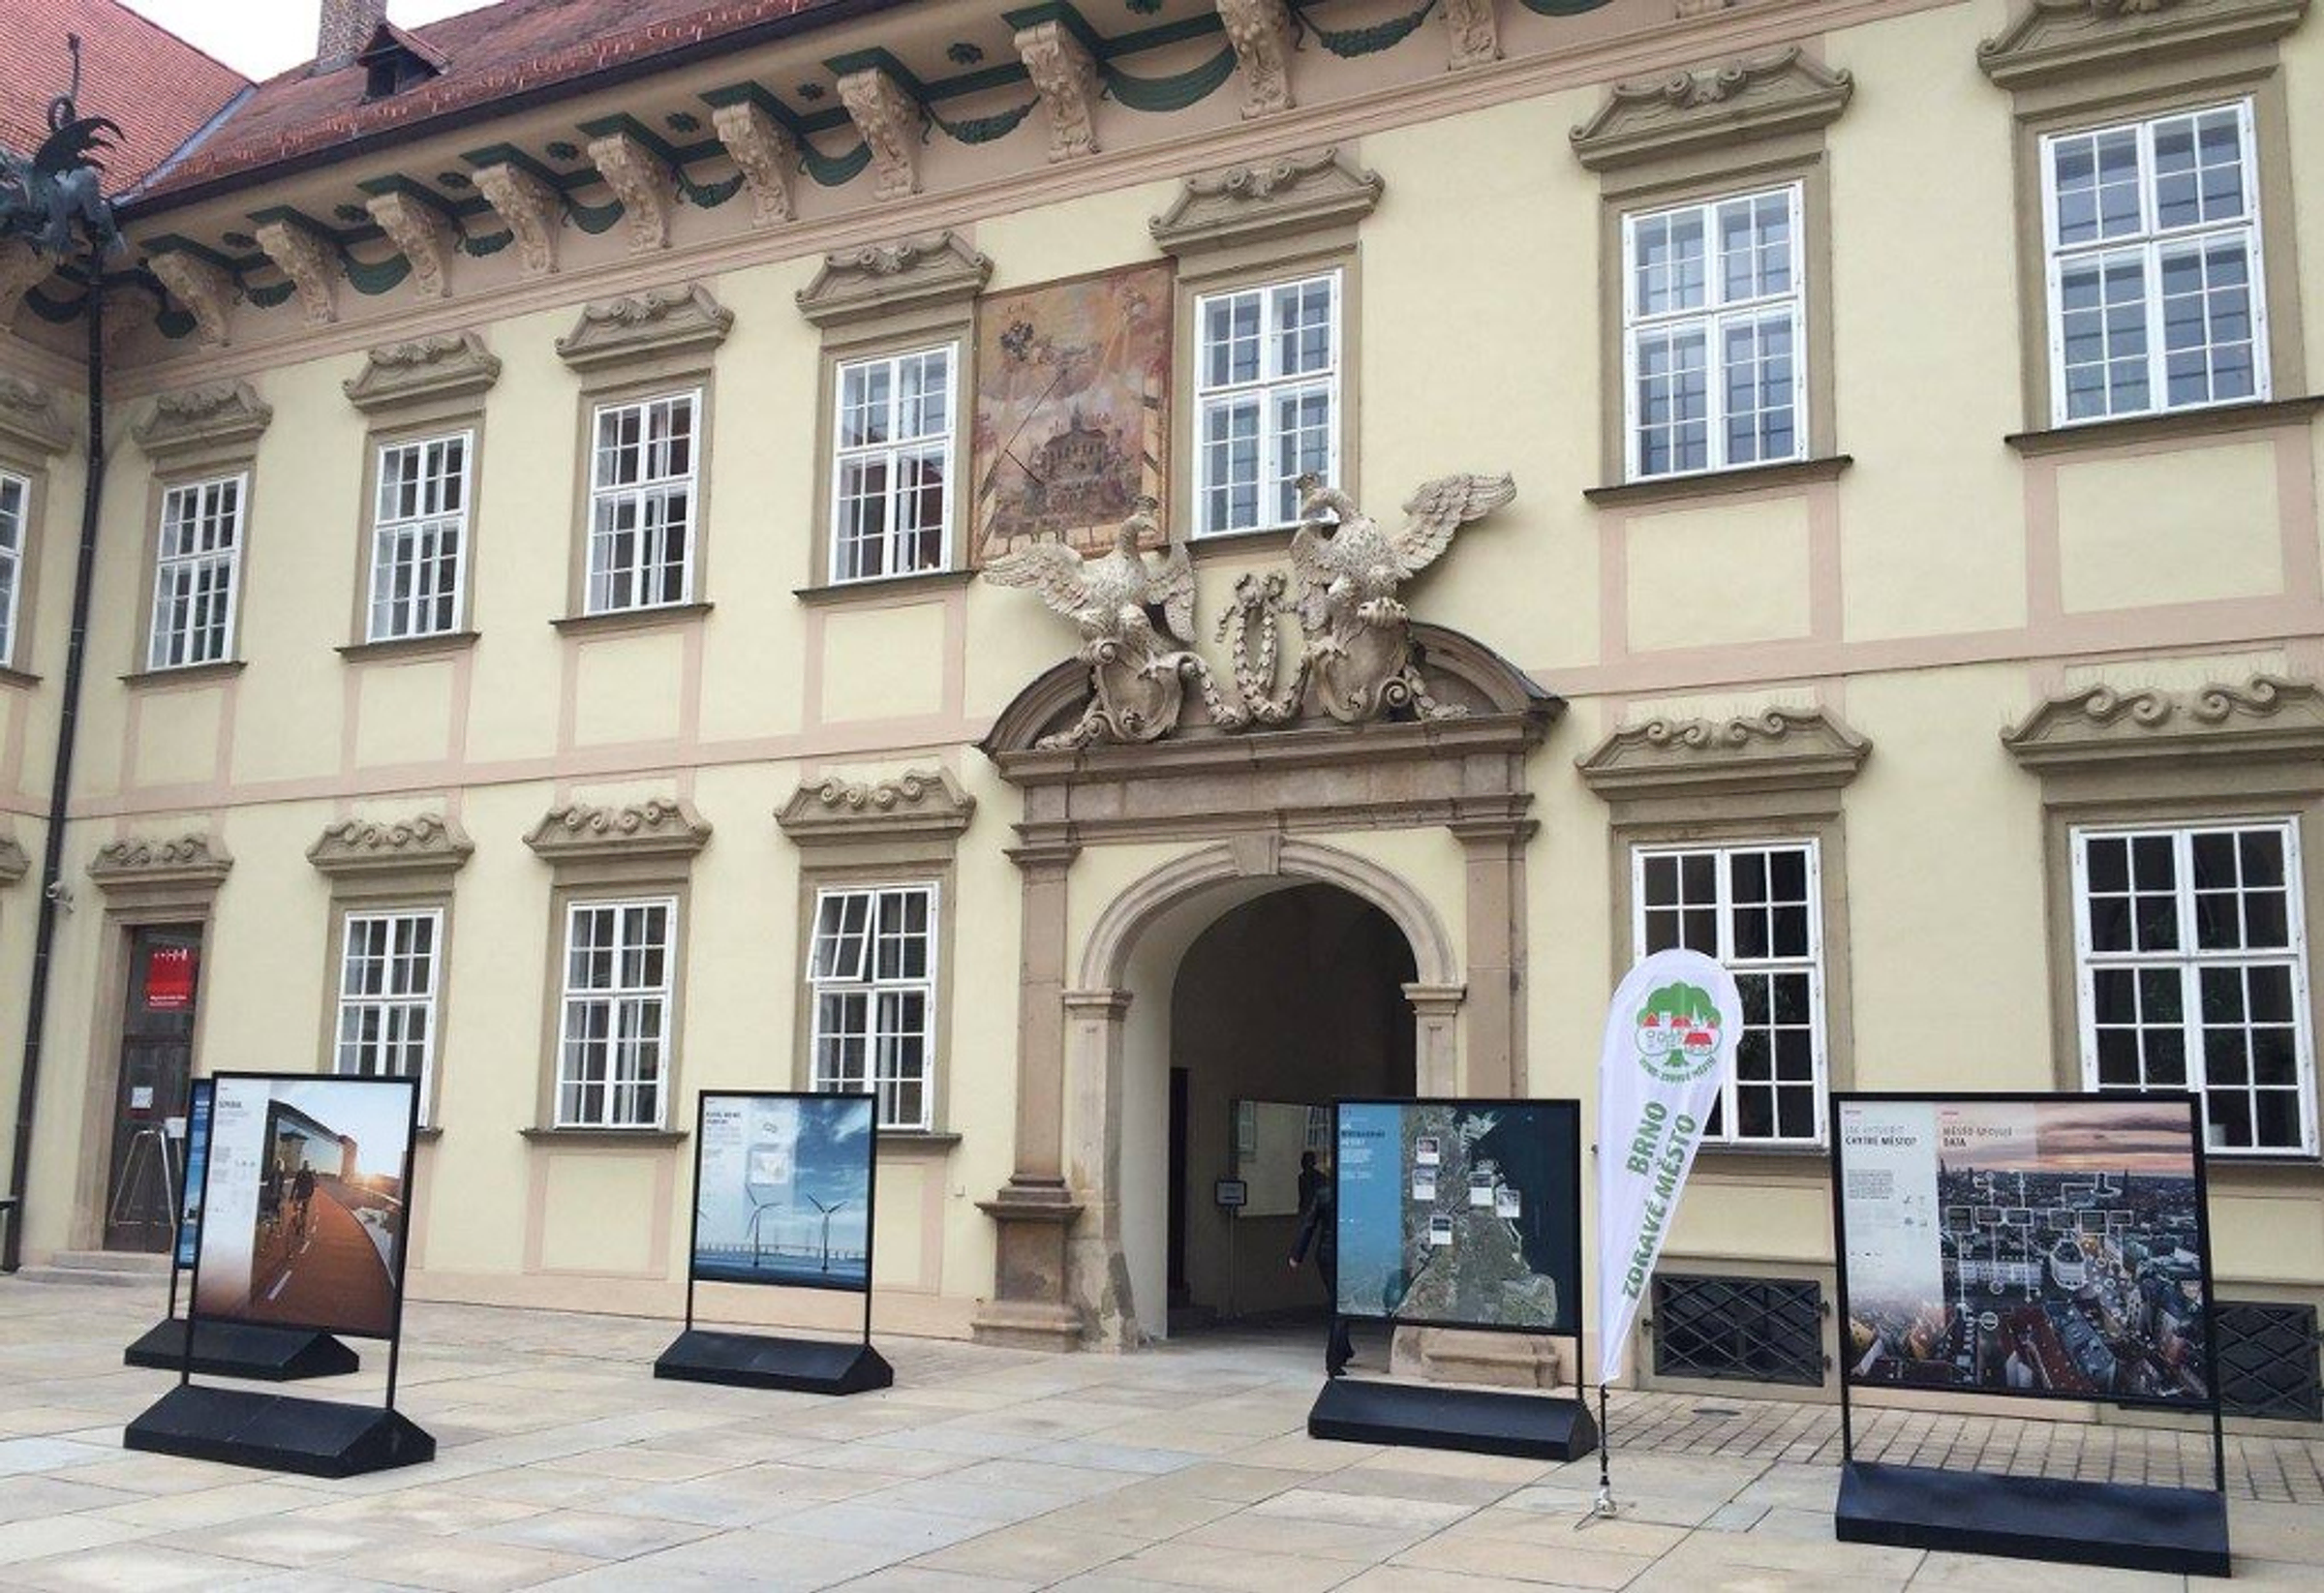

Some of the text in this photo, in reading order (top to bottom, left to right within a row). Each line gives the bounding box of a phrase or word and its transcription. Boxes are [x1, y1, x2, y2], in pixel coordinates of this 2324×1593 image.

[1626, 1101, 1667, 1177] BRNO
[1622, 1199, 1667, 1300] ZDRAVÉ
[1655, 1115, 1696, 1200] MĚSTO
